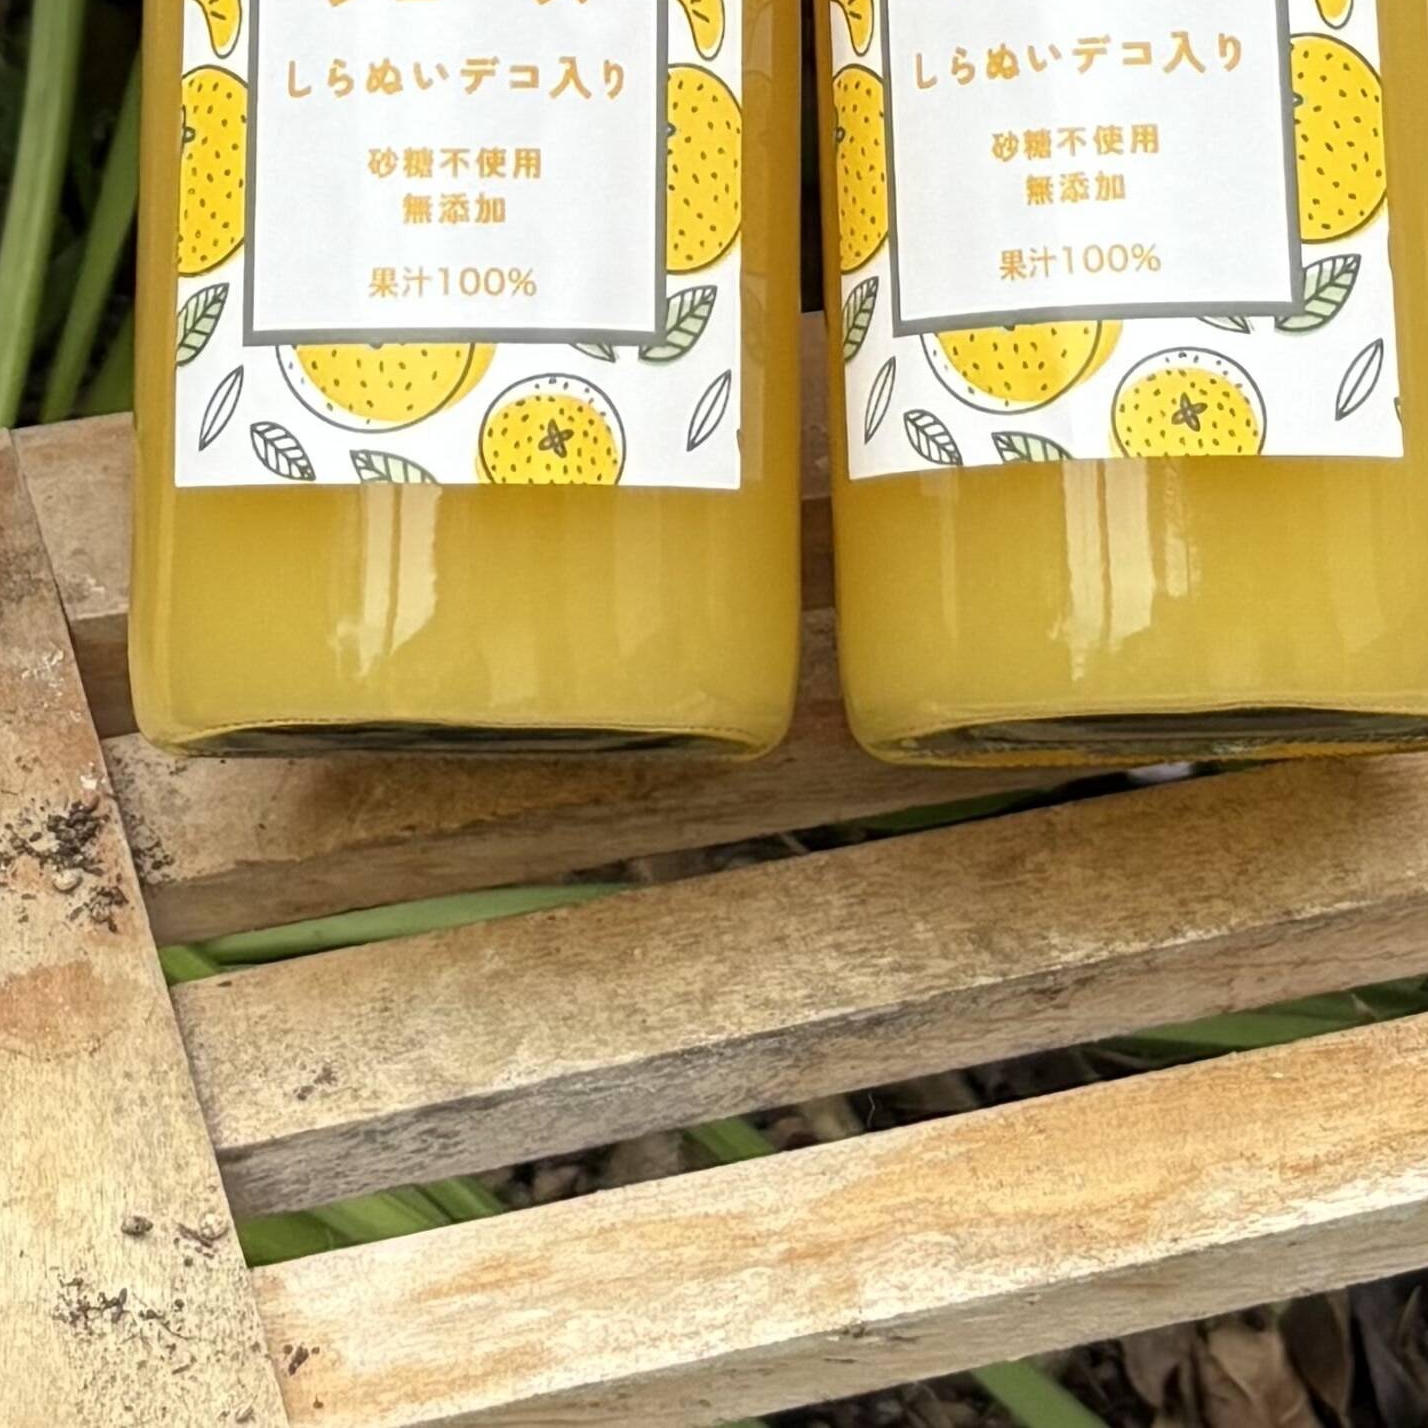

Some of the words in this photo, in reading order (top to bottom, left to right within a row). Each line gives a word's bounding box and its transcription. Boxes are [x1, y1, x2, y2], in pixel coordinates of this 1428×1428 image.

[914, 29, 1243, 90] しらぬいデコ入り
[286, 56, 626, 101] しらぬいデコ入り
[990, 123, 1161, 164] 砂糖不使用
[367, 147, 543, 180] 砂糖不使用
[1025, 171, 1128, 207] 無添加
[401, 192, 507, 225] 無添加
[998, 243, 1163, 282] 果汁100%
[368, 266, 539, 299] 果汁100%
